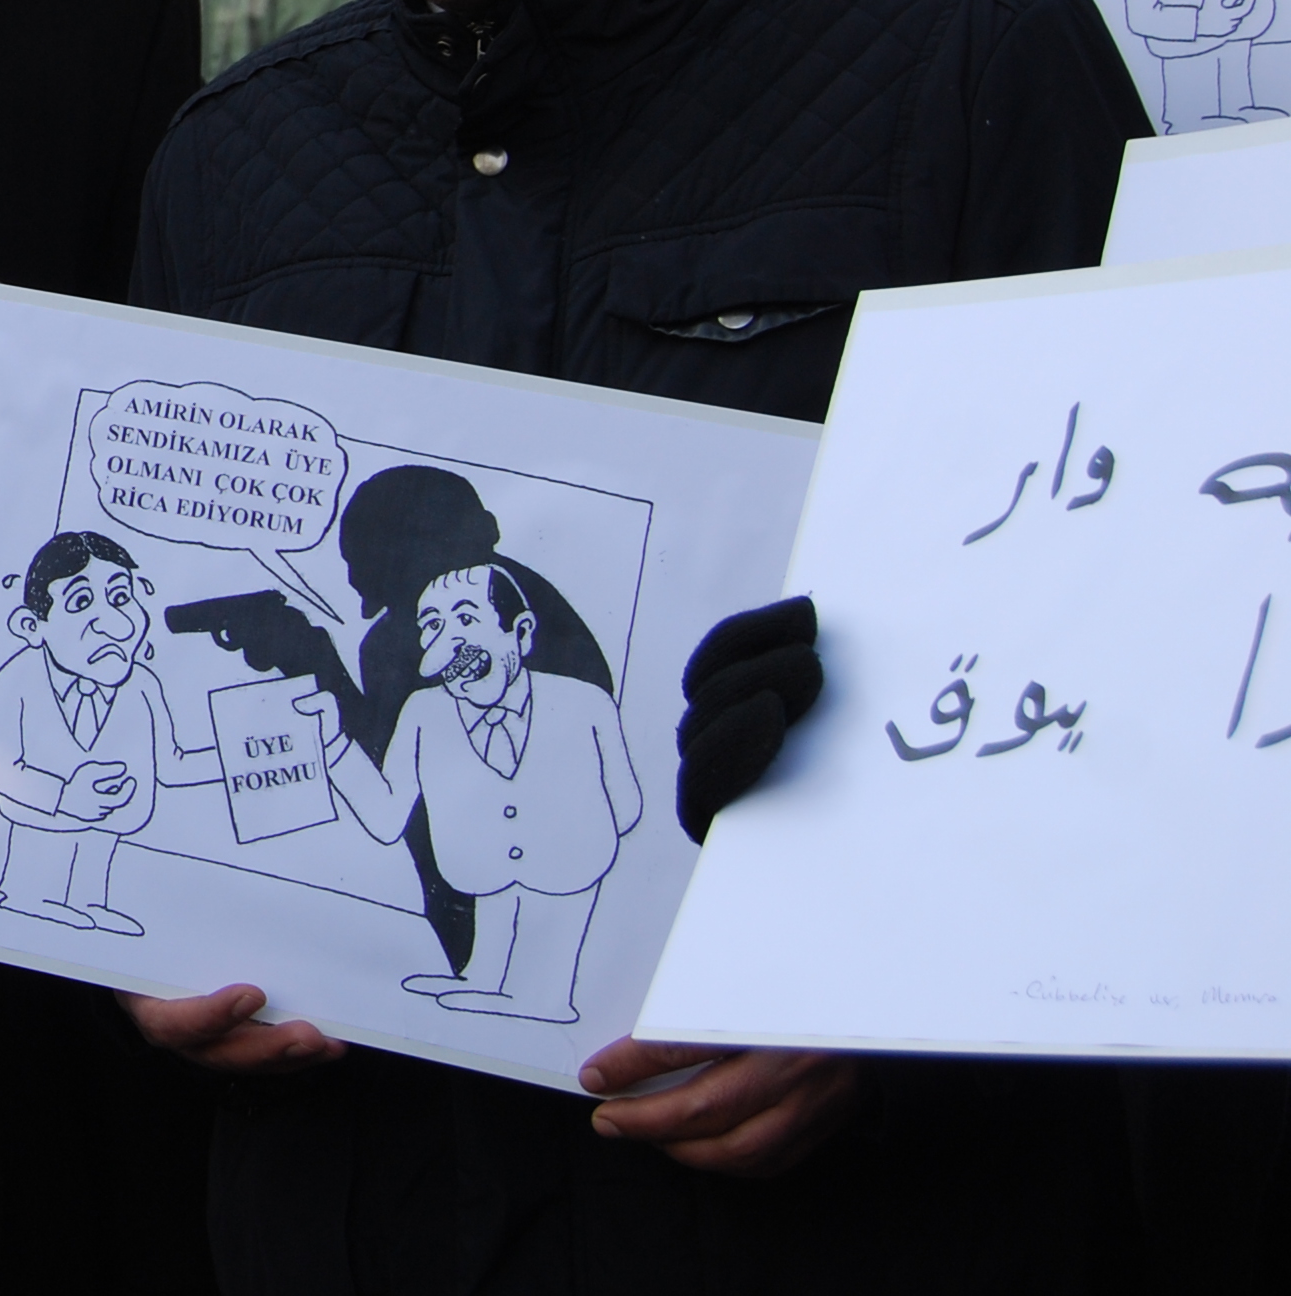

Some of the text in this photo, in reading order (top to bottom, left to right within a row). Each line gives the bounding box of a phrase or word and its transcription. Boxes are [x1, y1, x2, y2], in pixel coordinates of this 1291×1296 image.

[125, 398, 321, 443] AMİRİN OLARAK
[107, 423, 333, 476] SENDİKAMIZA ÜYE
[107, 455, 325, 507] OLMANI ÇOK ÇOK
[110, 486, 305, 536] RİCA EDİYORUM
[244, 732, 295, 760] ÜYE
[230, 760, 319, 795] FORMU
